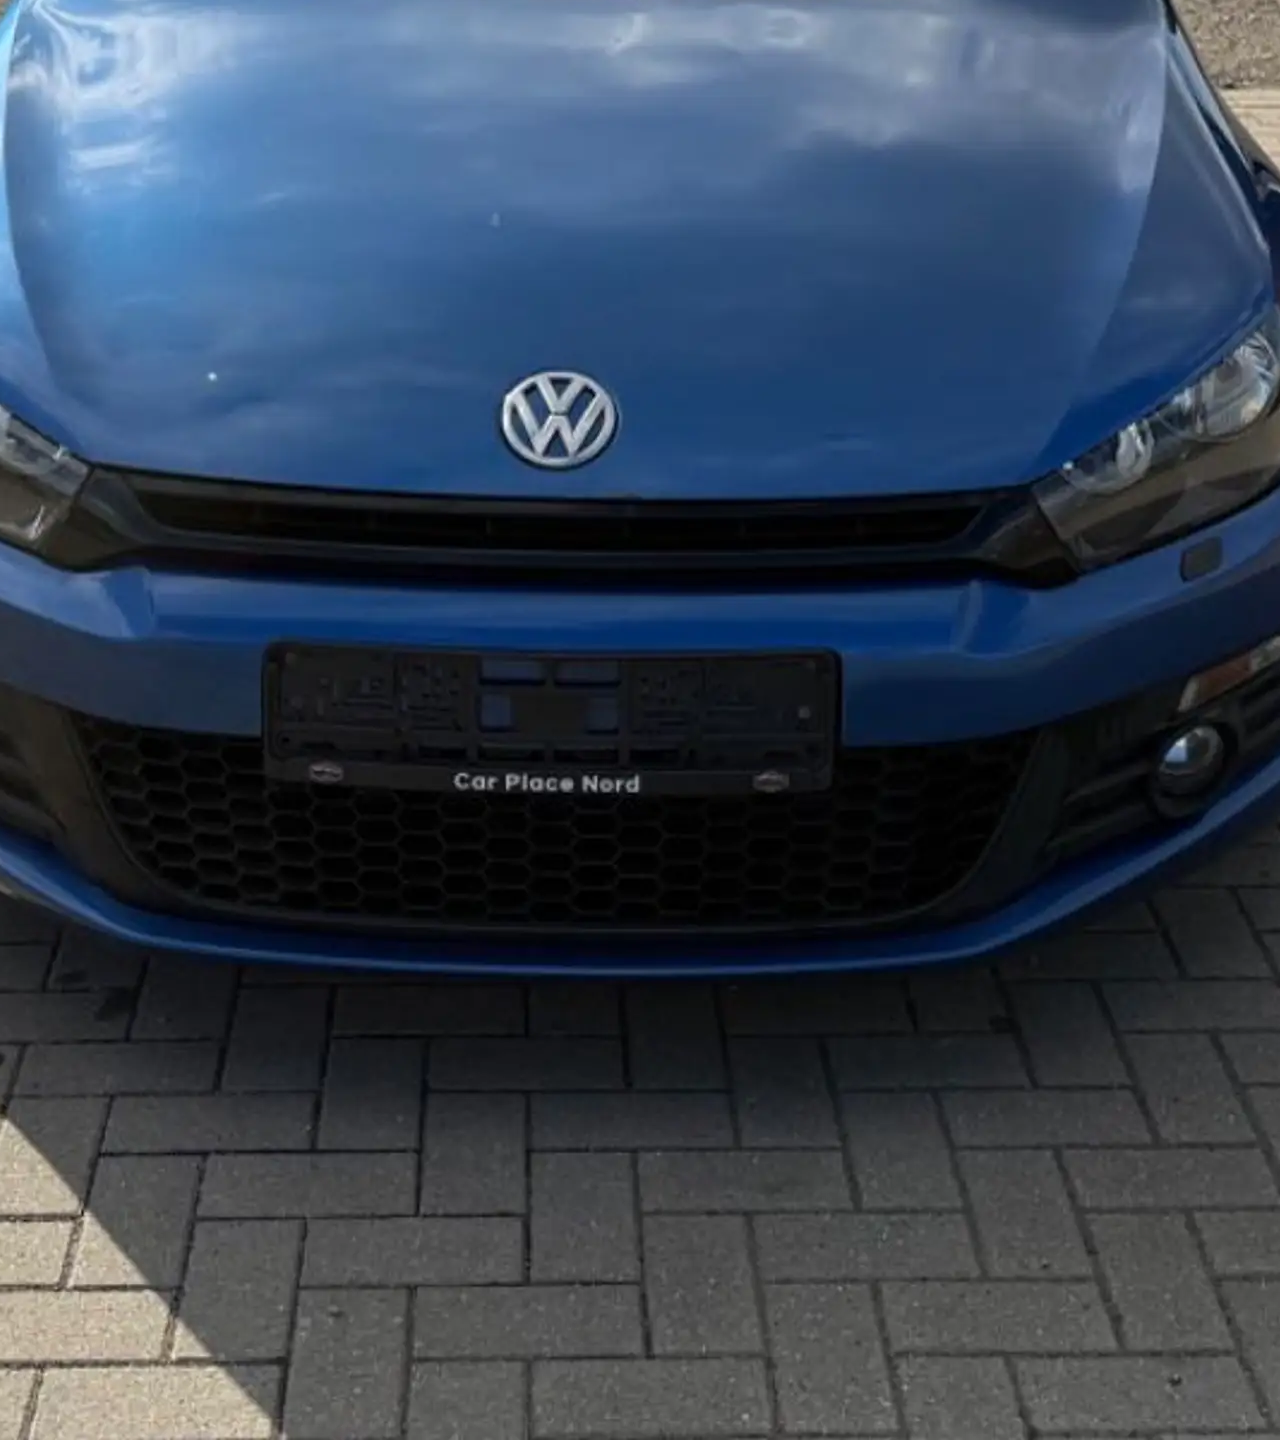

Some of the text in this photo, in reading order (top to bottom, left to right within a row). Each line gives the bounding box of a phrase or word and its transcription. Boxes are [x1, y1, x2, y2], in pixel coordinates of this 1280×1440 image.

[453, 772, 641, 793] Car Place Nord
